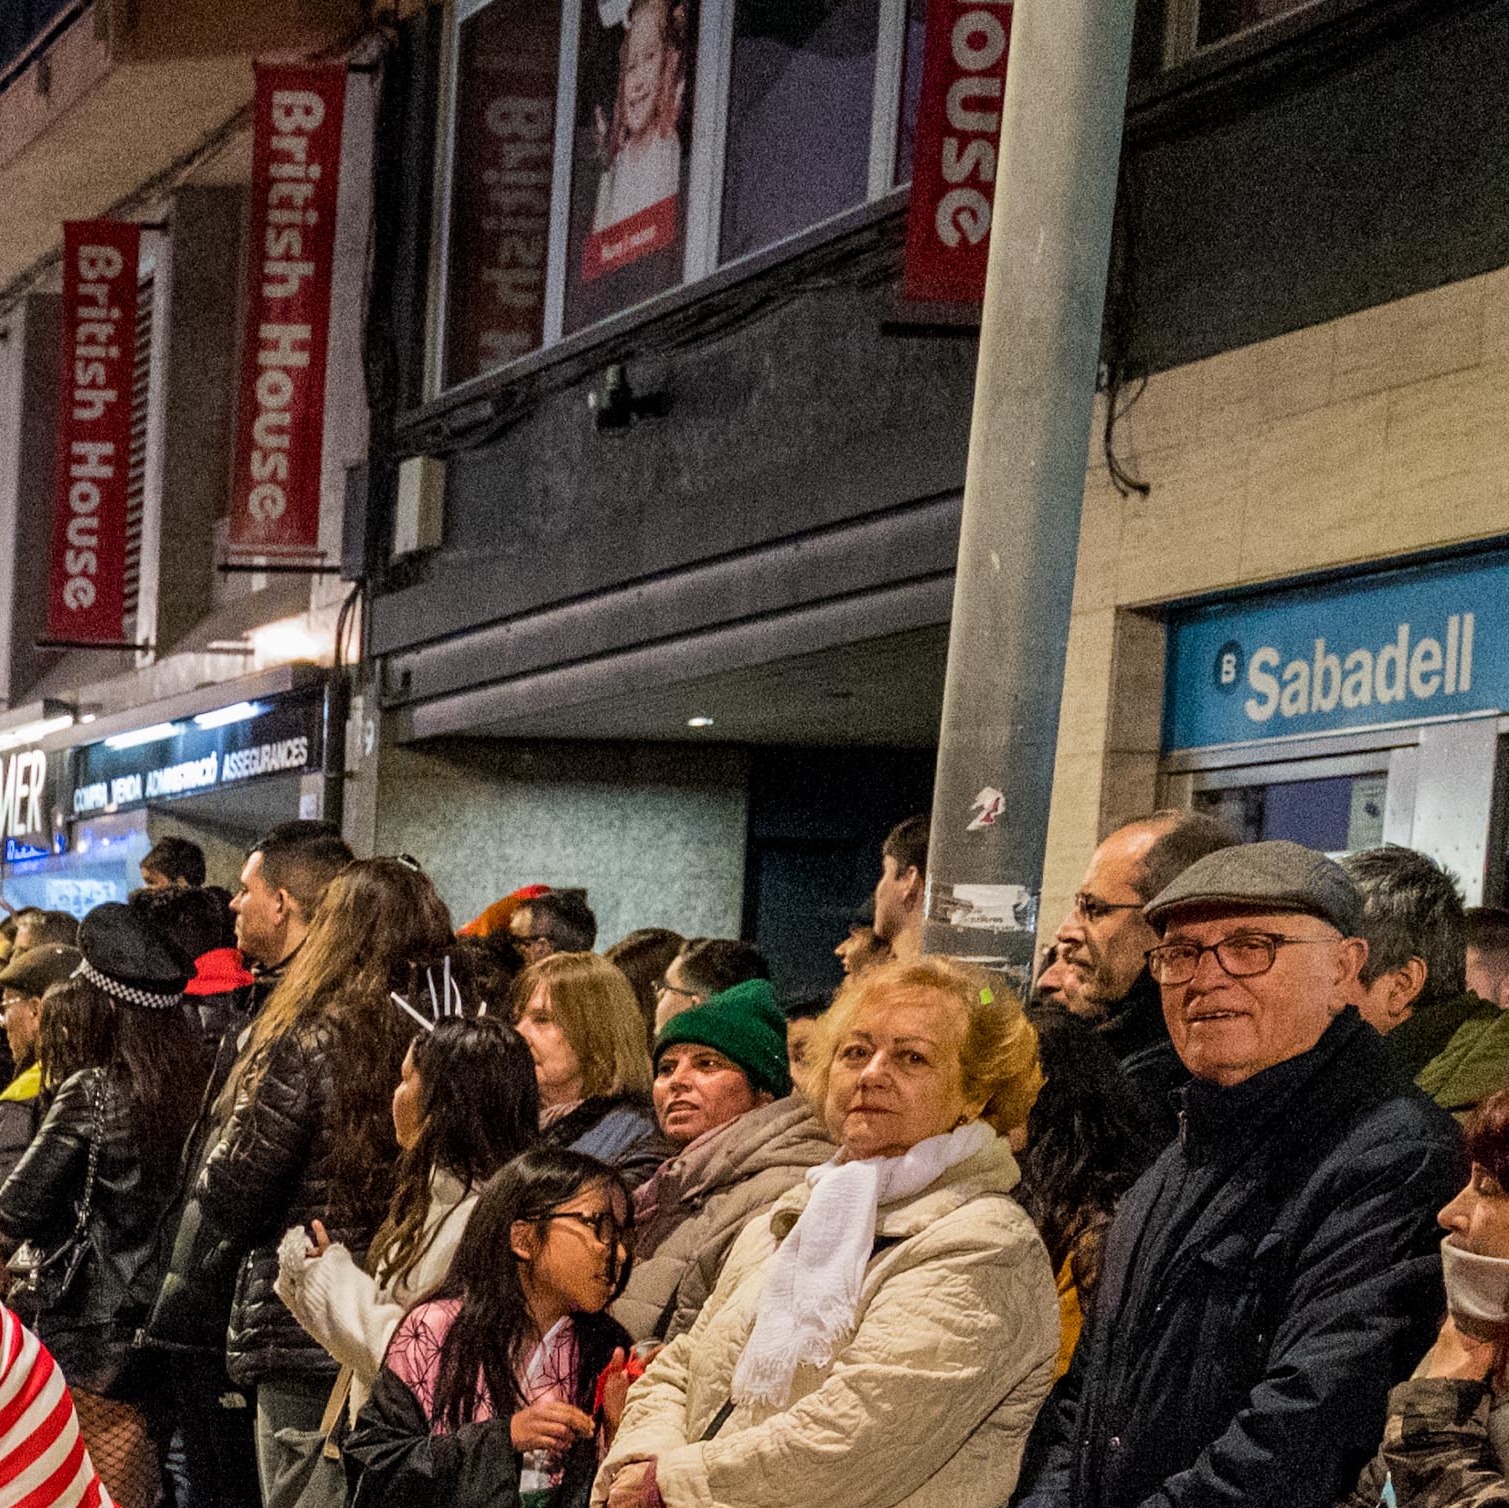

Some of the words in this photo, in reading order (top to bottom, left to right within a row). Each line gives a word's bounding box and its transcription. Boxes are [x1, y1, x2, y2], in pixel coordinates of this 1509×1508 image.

[262, 88, 325, 299] British
[935, 0, 1006, 248] ouse
[71, 244, 123, 419] British
[247, 322, 313, 520] House
[62, 441, 116, 611] House
[1243, 612, 1475, 722] Sabadell
[221, 736, 308, 782] ASSEGURANCES
